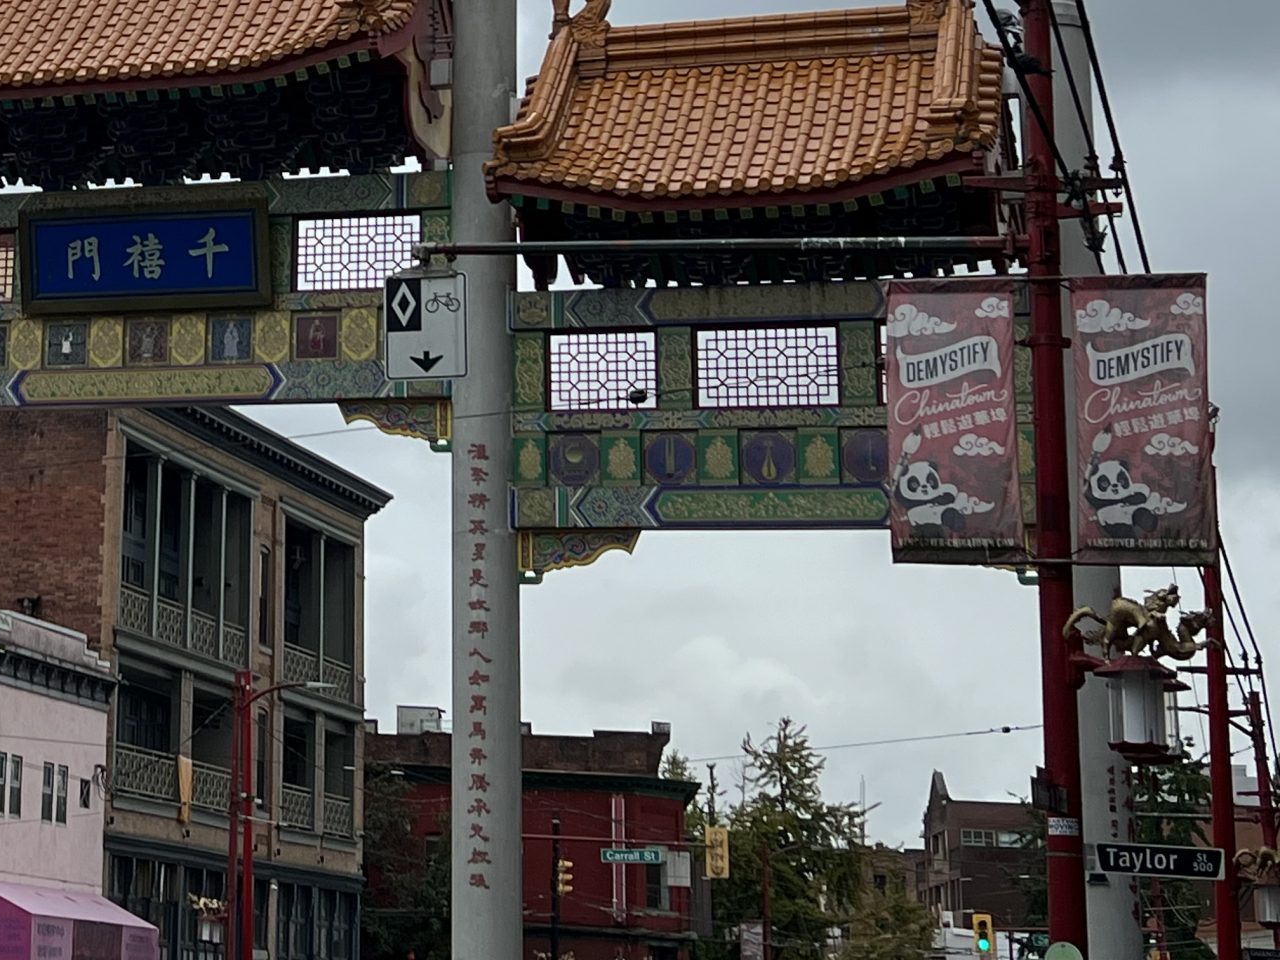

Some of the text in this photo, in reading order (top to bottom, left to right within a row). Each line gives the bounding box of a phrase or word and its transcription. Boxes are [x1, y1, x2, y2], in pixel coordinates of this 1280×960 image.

[67, 227, 229, 281] 千禧門
[906, 341, 990, 383] DEMYSTIFY
[1096, 339, 1184, 380] DEMYSTIFY
[894, 382, 1008, 425] Chinatown
[1084, 380, 1202, 423] Chinatown
[643, 851, 656, 861] St
[1106, 848, 1207, 872] Taylor St
